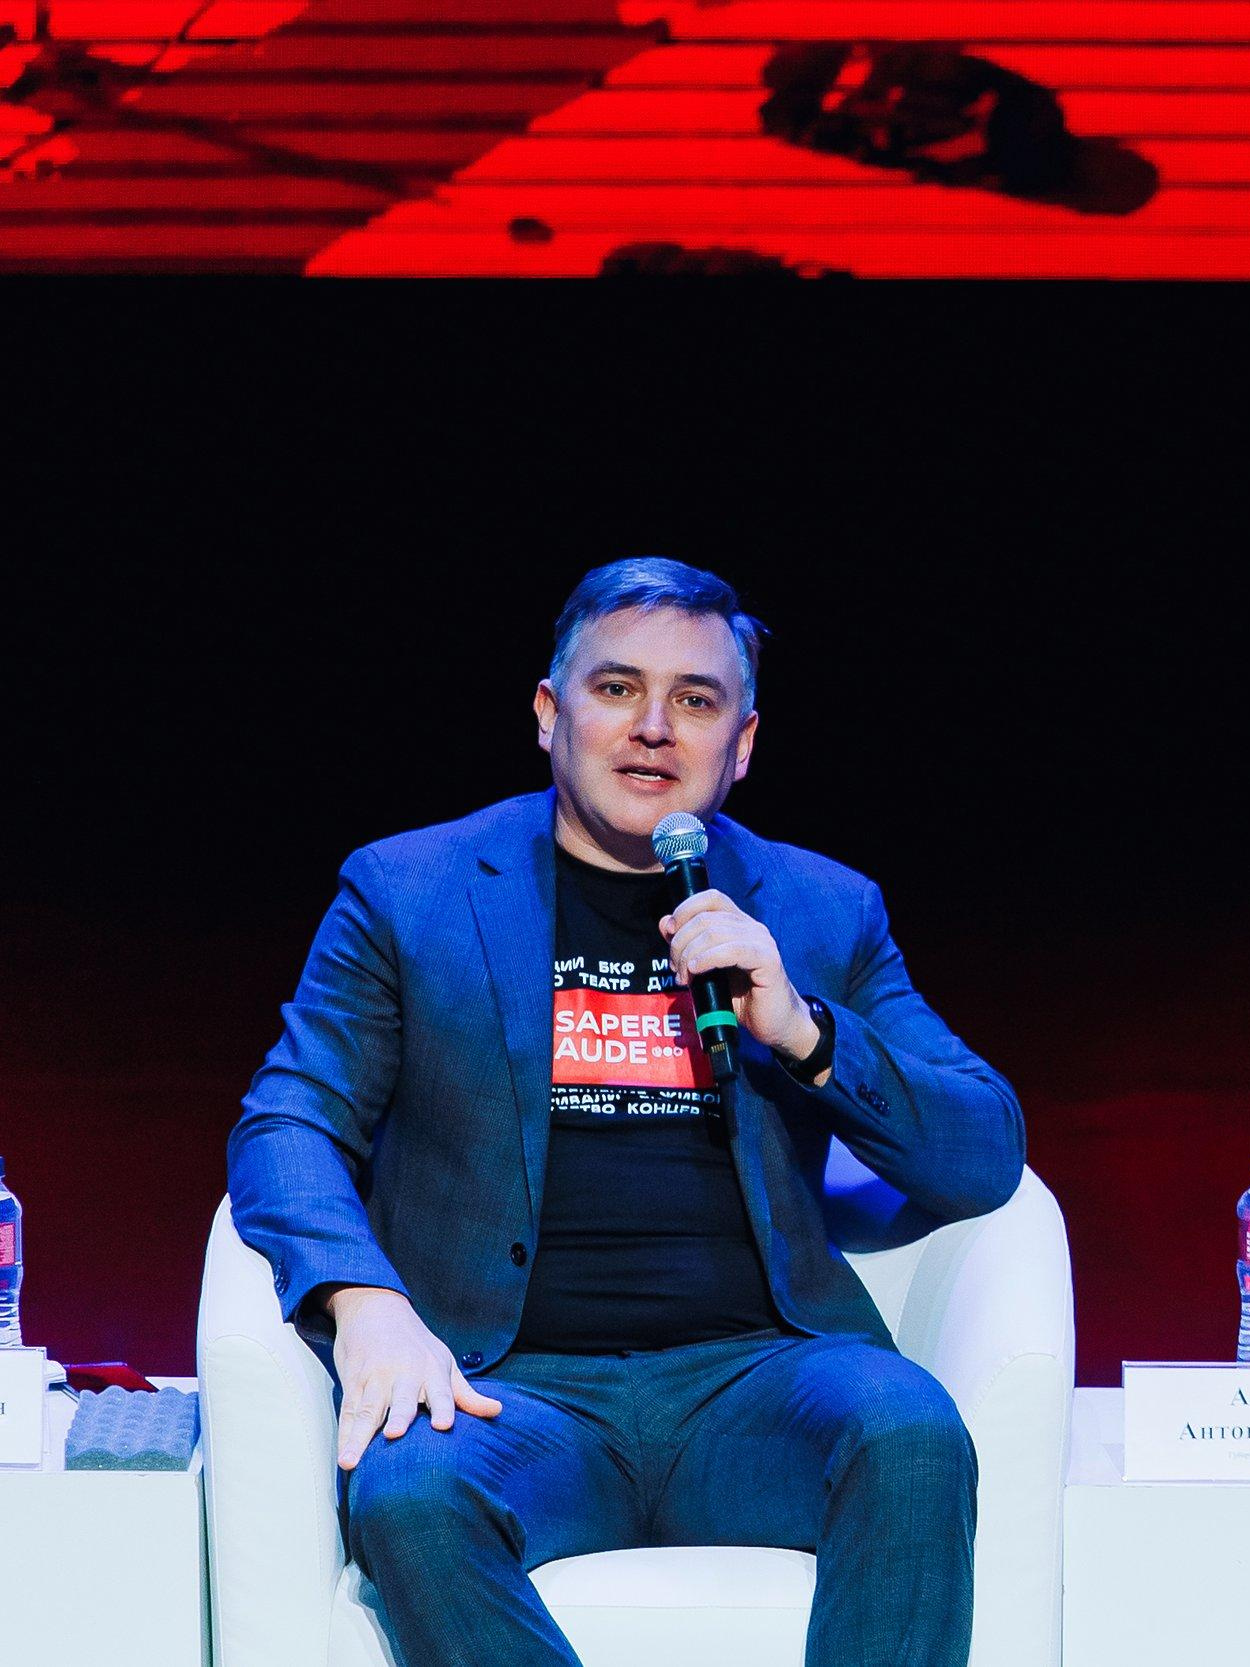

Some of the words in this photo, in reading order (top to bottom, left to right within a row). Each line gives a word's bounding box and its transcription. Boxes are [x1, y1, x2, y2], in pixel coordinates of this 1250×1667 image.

[598, 960, 635, 975] БКФ
[578, 972, 631, 991] ТЕАТР
[647, 975, 679, 992] ДИ
[555, 1010, 682, 1038] SAPERE
[554, 1037, 648, 1064] AUDE
